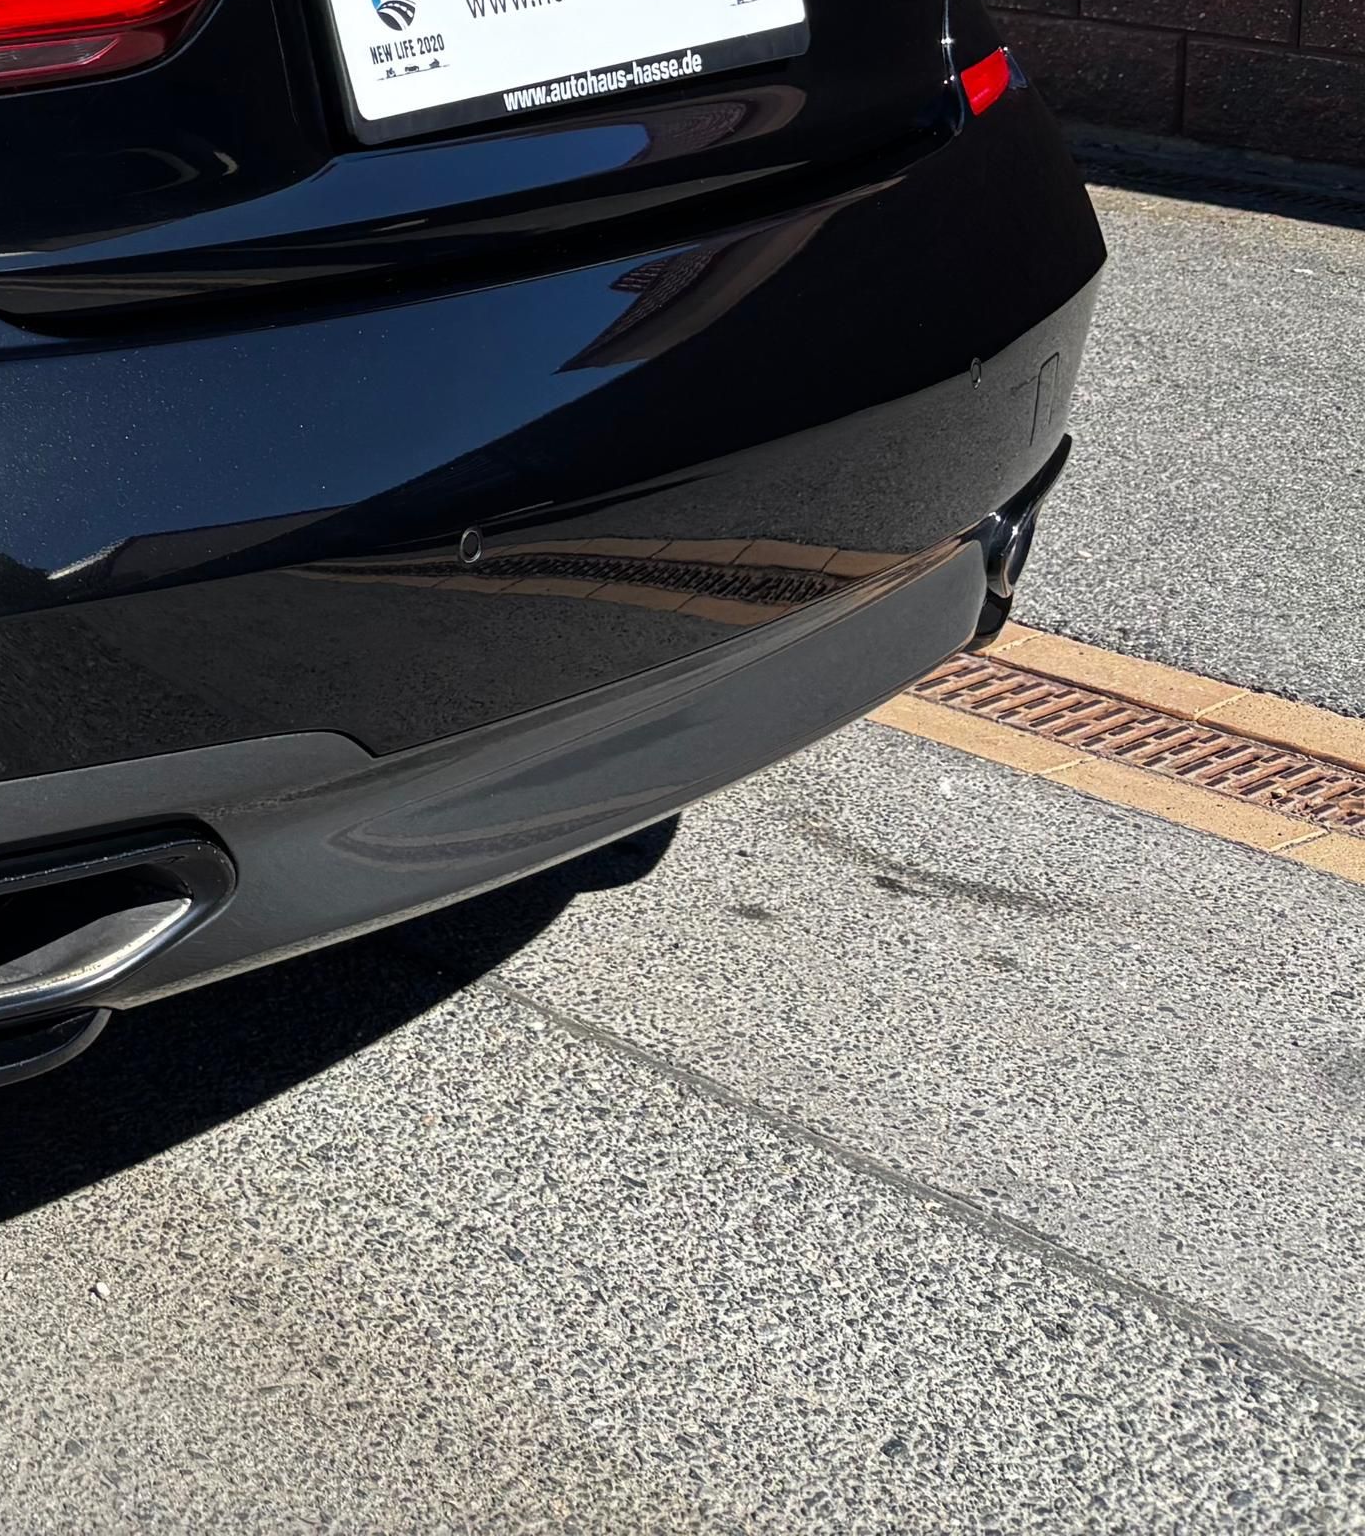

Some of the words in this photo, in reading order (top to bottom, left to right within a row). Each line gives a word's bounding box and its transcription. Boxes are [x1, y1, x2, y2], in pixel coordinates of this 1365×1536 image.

[369, 43, 393, 65] NEW
[394, 39, 416, 60] LIFE
[417, 33, 445, 55] 2020
[503, 49, 703, 111] www.autohaus-hasse.de
